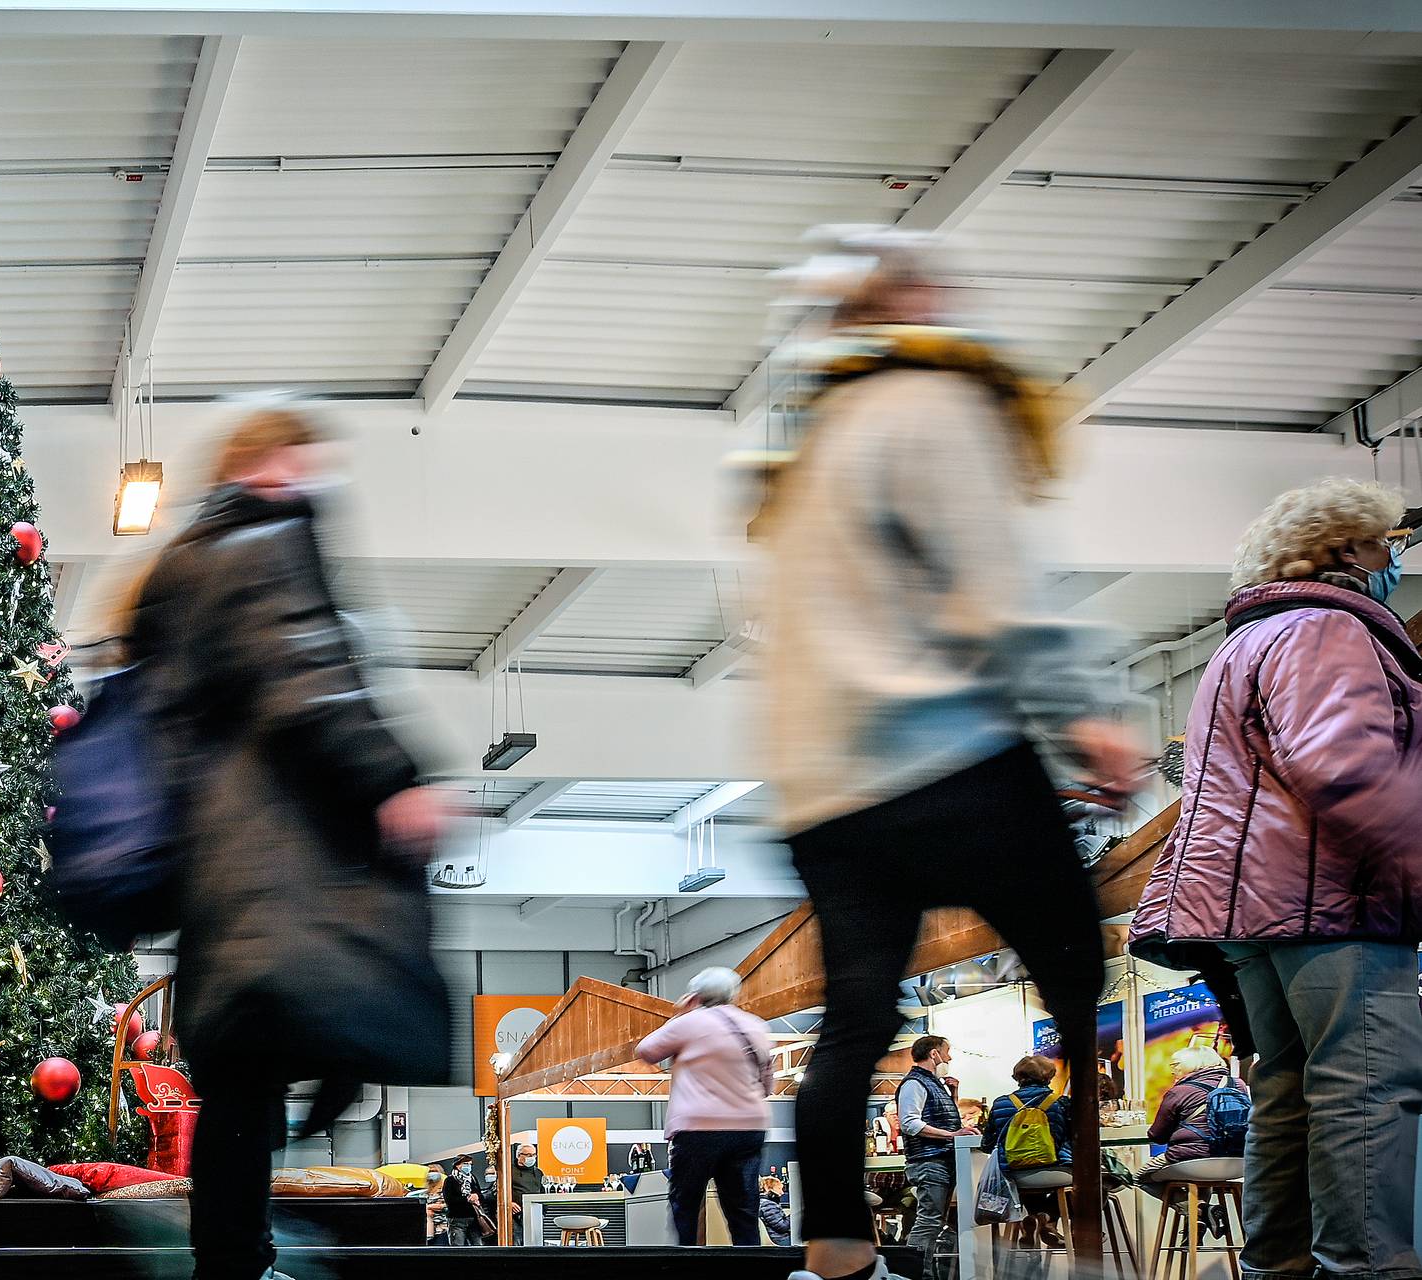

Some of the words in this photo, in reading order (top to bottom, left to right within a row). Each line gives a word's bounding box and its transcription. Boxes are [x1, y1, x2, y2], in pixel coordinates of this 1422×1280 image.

[1153, 1001, 1201, 1020] PIEROTH
[497, 1031, 529, 1043] SNA
[553, 1141, 590, 1150] SNACK
